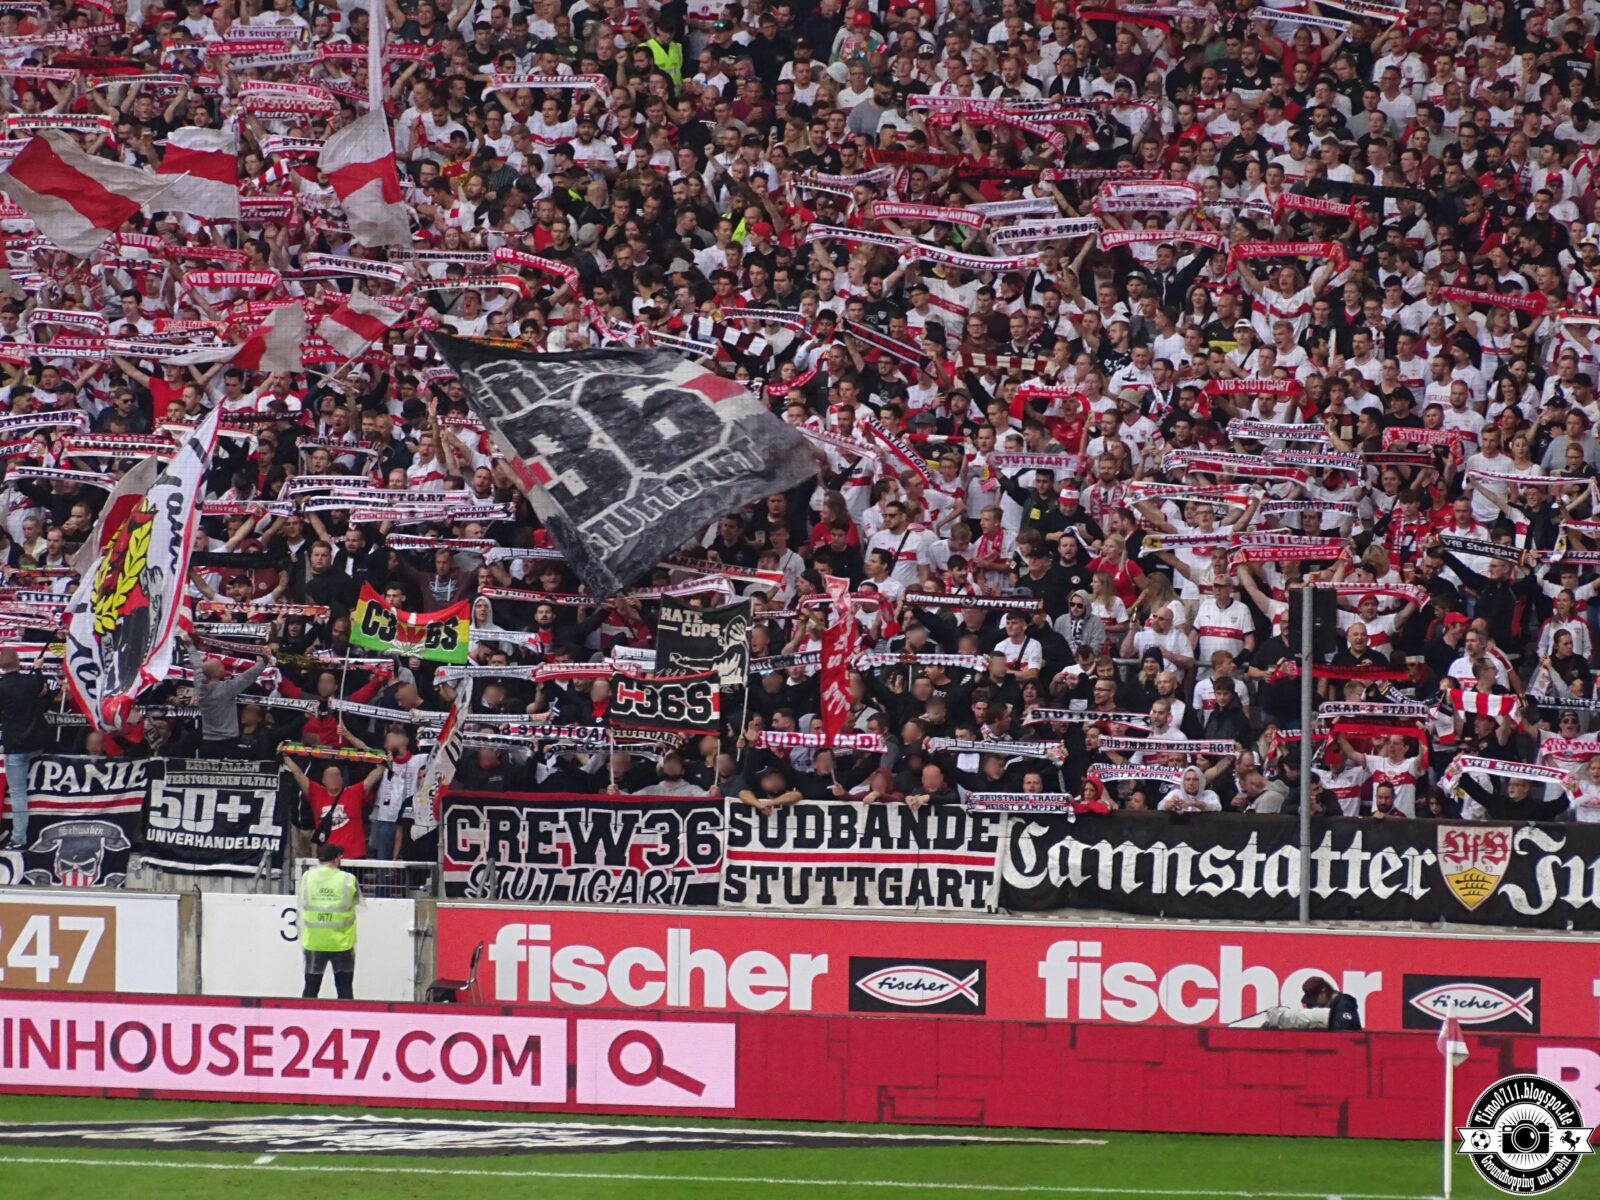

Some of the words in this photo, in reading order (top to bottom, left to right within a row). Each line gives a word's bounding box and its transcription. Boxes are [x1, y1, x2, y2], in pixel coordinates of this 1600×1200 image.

[504, 74, 528, 84] VfB
[532, 73, 598, 85] Stuttgart
[319, 256, 394, 275] STUTTGART
[925, 250, 945, 261] VfB
[951, 255, 1013, 270] Stuttgart
[188, 272, 210, 285] VfB
[213, 271, 279, 285] STUTTGART
[1216, 379, 1236, 392] VfB
[1238, 379, 1292, 392] STUTTGART
[1399, 431, 1451, 446] STUTTGART
[995, 454, 1072, 468] STUTTGART
[289, 478, 370, 490] STUTTGART
[357, 491, 447, 503] STUTTGART
[1239, 535, 1333, 547] STUTTGART
[1442, 537, 1463, 549] VfB
[1466, 542, 1520, 560] Stuttgart
[1249, 548, 1273, 558] VfB
[1282, 549, 1339, 559] Stuttgart
[681, 577, 725, 591] KURVE
[976, 598, 1040, 610] STUTTGART
[660, 607, 703, 625] HATE
[209, 622, 269, 636] KOMPANIE
[681, 623, 721, 638] COPS
[1100, 736, 1122, 750] FÜR
[1124, 739, 1163, 751] IMMER
[1166, 742, 1201, 752] WEISS
[221, 759, 261, 773] ALLEN
[1466, 758, 1490, 769] VfB
[1494, 761, 1565, 778] Stuttgart
[166, 774, 241, 788] VERSTORBENEN
[241, 775, 279, 788] ULTRAS
[980, 794, 1030, 802] BRUSTRING
[1034, 794, 1069, 802] TRAGEN
[149, 778, 283, 837] 50+1
[146, 829, 281, 851] UNVERHANDELBAR
[444, 804, 640, 868] CREW
[641, 807, 724, 868] 36
[1002, 816, 1437, 901] Cannstatter
[465, 863, 699, 905] STUTTGART
[723, 864, 994, 909] STUTTGART
[0, 914, 106, 984] 47
[488, 923, 829, 1011] fischer
[877, 976, 951, 992] fischer
[2, 1017, 542, 1087] INHOUSE247.COM
